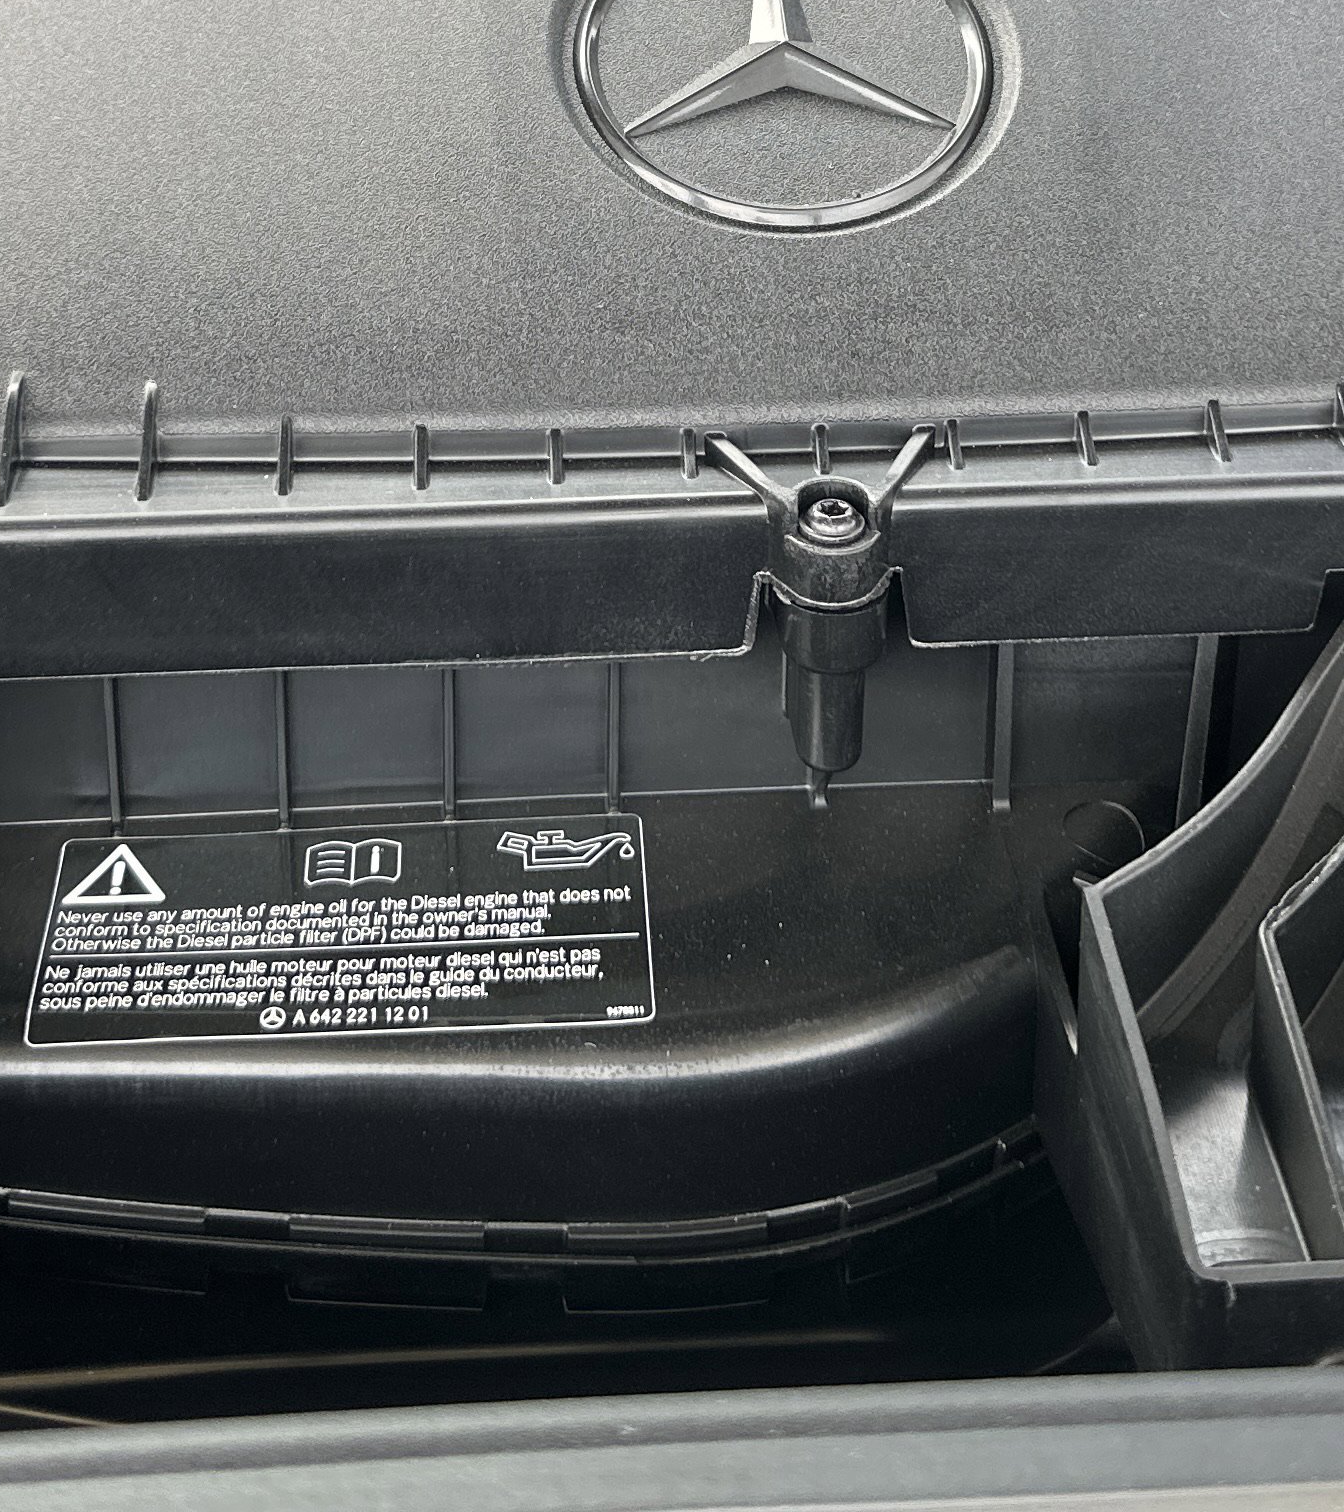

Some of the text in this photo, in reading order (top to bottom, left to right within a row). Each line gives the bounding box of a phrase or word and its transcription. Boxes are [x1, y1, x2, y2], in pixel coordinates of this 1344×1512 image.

[53, 903, 552, 940] conform to specification documented in the owner's manual.
[56, 885, 632, 925] Never use any amount of engine oil for the Diesel engine that does not
[51, 918, 546, 952] Otherwise the Diesel particle filter (DPF) could be damaged.
[41, 961, 604, 994] conforme aux spécifications décrites dans le guide du conducteur,
[44, 946, 601, 982] Ne jamais utiliser une huile moteur pour moteur diesel qui n'est pas
[39, 981, 489, 1012] sous peine d'endommager le filtre à particules diesel.
[292, 1005, 428, 1026] A 642 221 12 01
